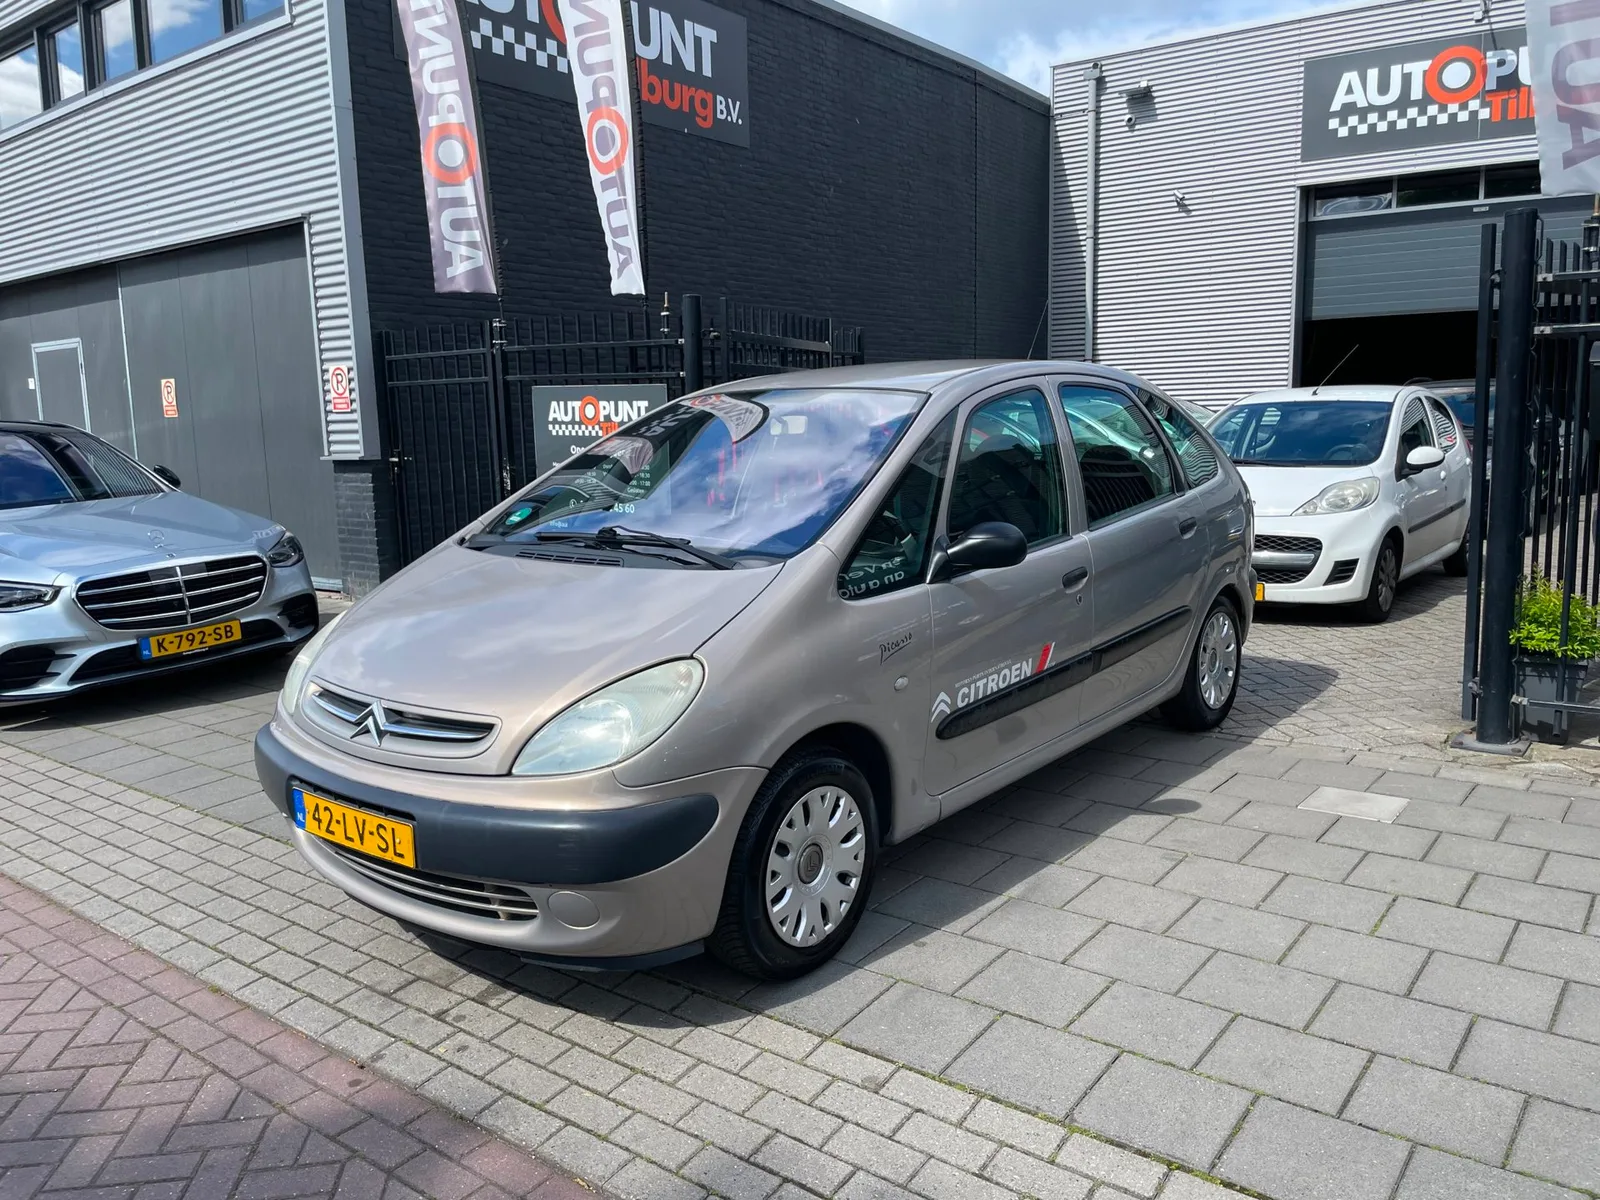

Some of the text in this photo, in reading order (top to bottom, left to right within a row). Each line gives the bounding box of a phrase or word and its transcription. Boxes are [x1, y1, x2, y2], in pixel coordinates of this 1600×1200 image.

[636, 57, 743, 129] burg B.V.
[548, 395, 649, 427] AUTOPUNT
[156, 624, 234, 653] K-792-SB
[956, 658, 1033, 708] CITROEN
[312, 802, 405, 859] 42-LV-SL
